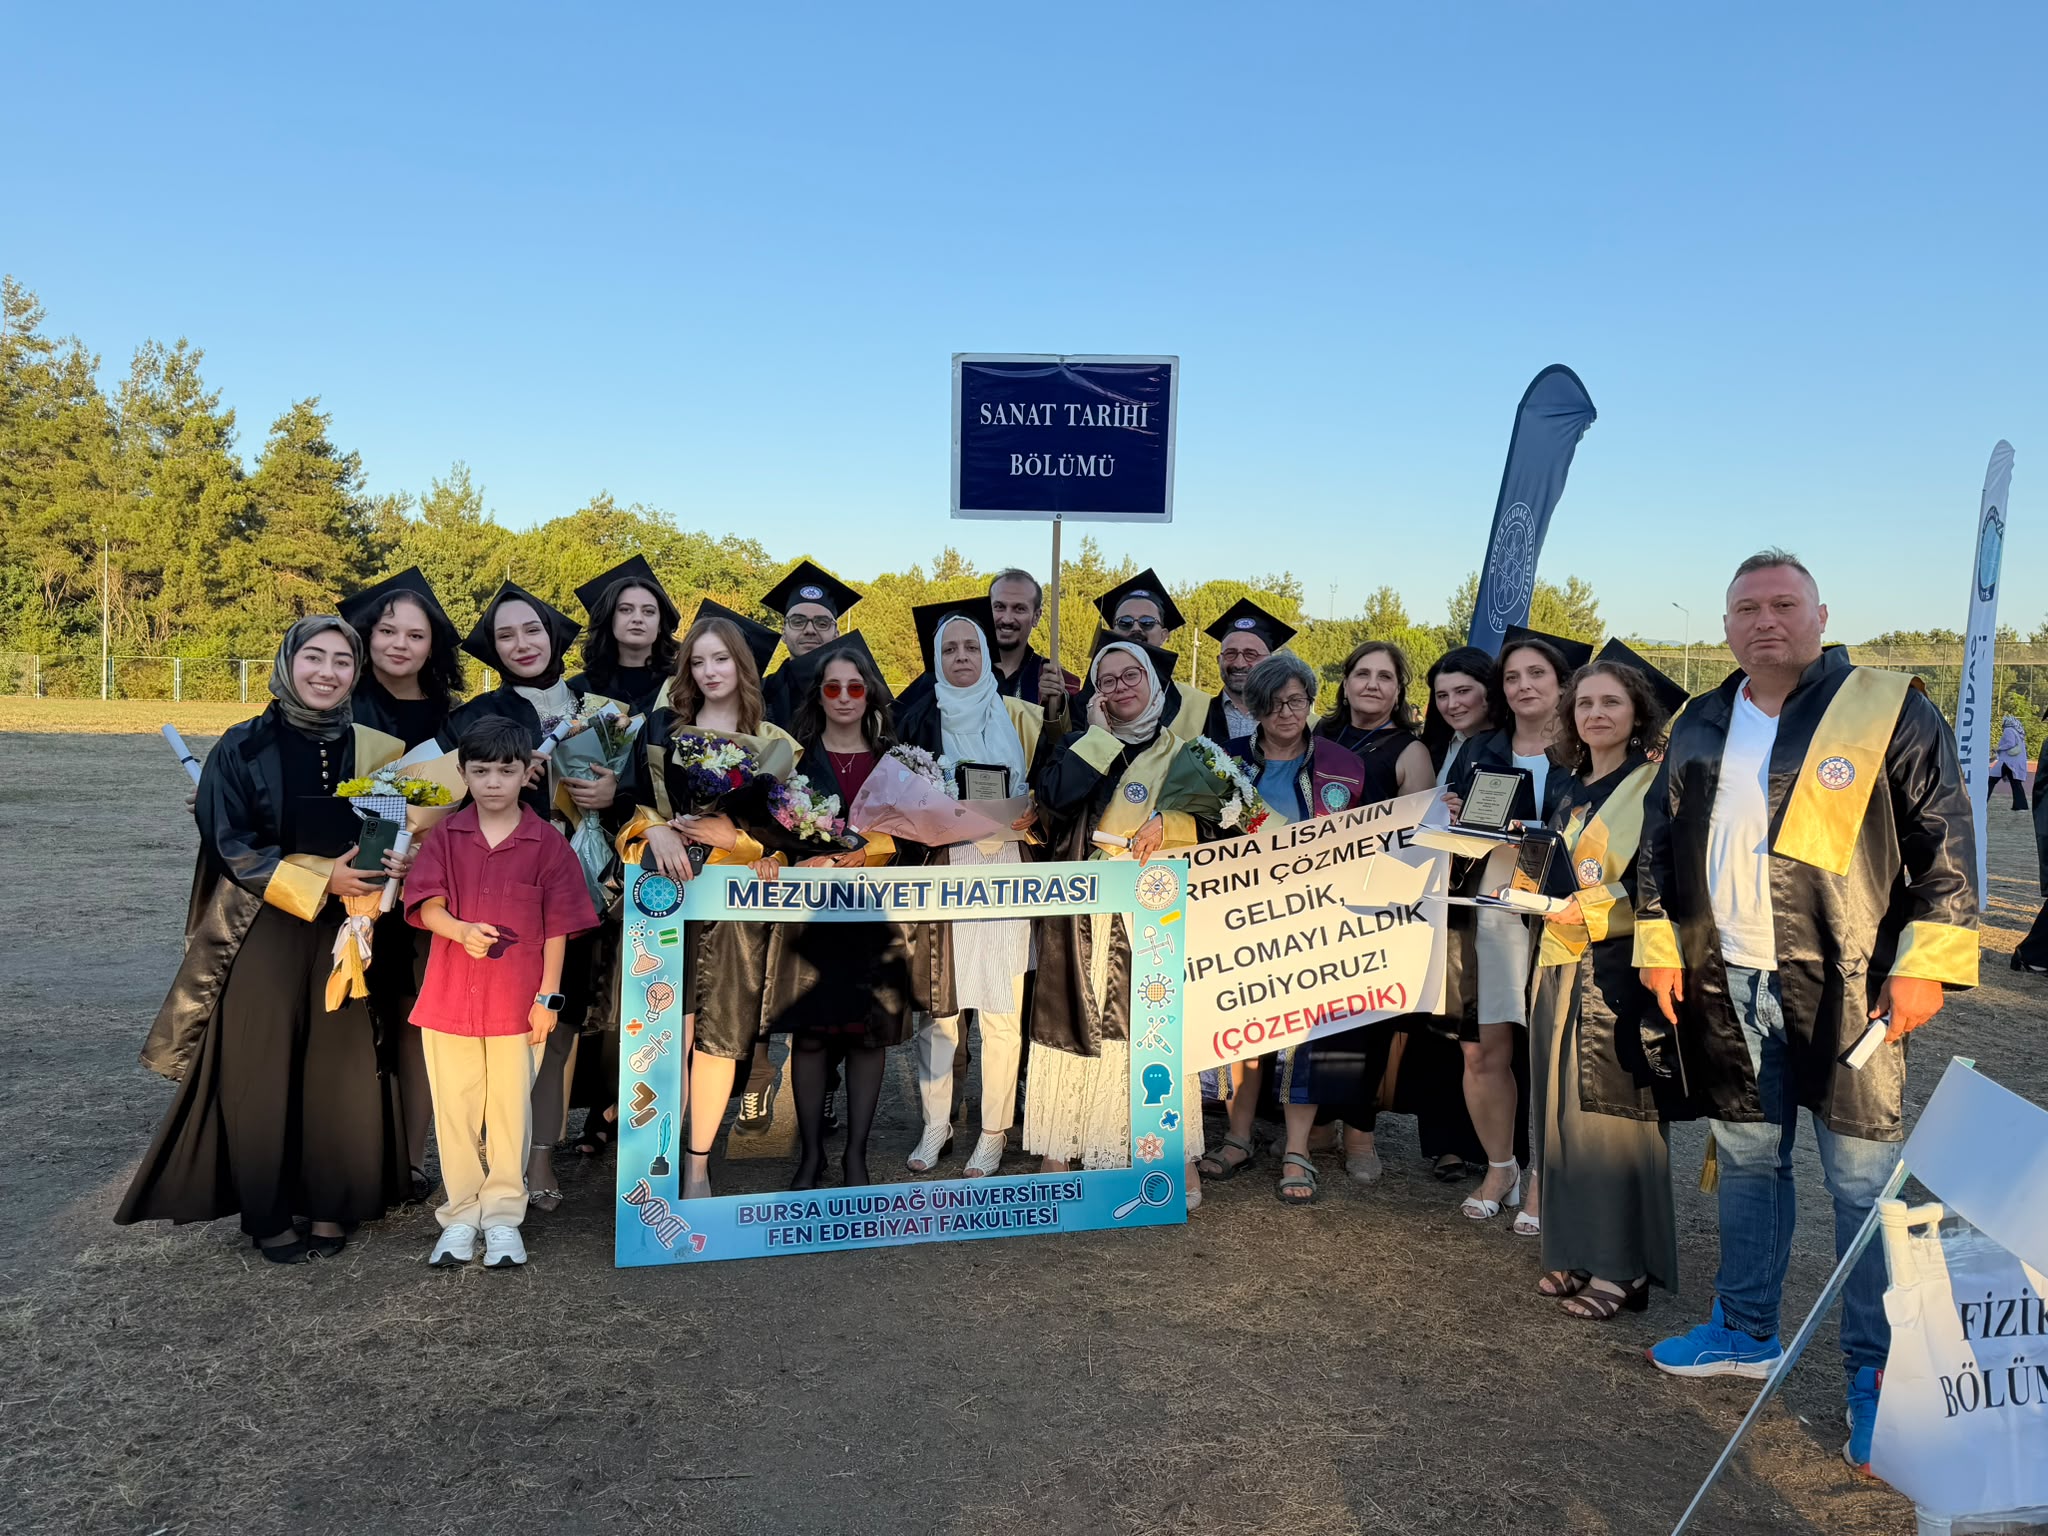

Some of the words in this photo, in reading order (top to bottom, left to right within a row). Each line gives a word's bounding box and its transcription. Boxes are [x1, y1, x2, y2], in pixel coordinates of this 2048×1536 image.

[980, 402, 1057, 426] SANAT
[1064, 401, 1148, 428] TARİHİ
[1009, 453, 1116, 477] BÖLÜMÜ
[1490, 609, 1503, 629] 1975
[1269, 826, 1416, 884] ÇÖZMEYE
[726, 874, 933, 909] MEZUNİYET
[940, 875, 1098, 908] HATIRASI
[1224, 884, 1345, 930] GELDİK,
[1183, 926, 1328, 983] İPLOMAYI
[1337, 901, 1428, 943] ALDIK
[1216, 949, 1388, 1012] GİDİYORUZ!
[1213, 982, 1407, 1059] (ÇÖZEMEDİK)
[739, 1201, 822, 1225] BURSA
[828, 1188, 925, 1218] ULUDAĞ
[931, 1178, 1083, 1210] ÜNİVERSİTESİ
[768, 1226, 813, 1247] FEN
[819, 1215, 933, 1243] EDEBİYAT
[939, 1202, 1059, 1232] FAKÜLTESİ
